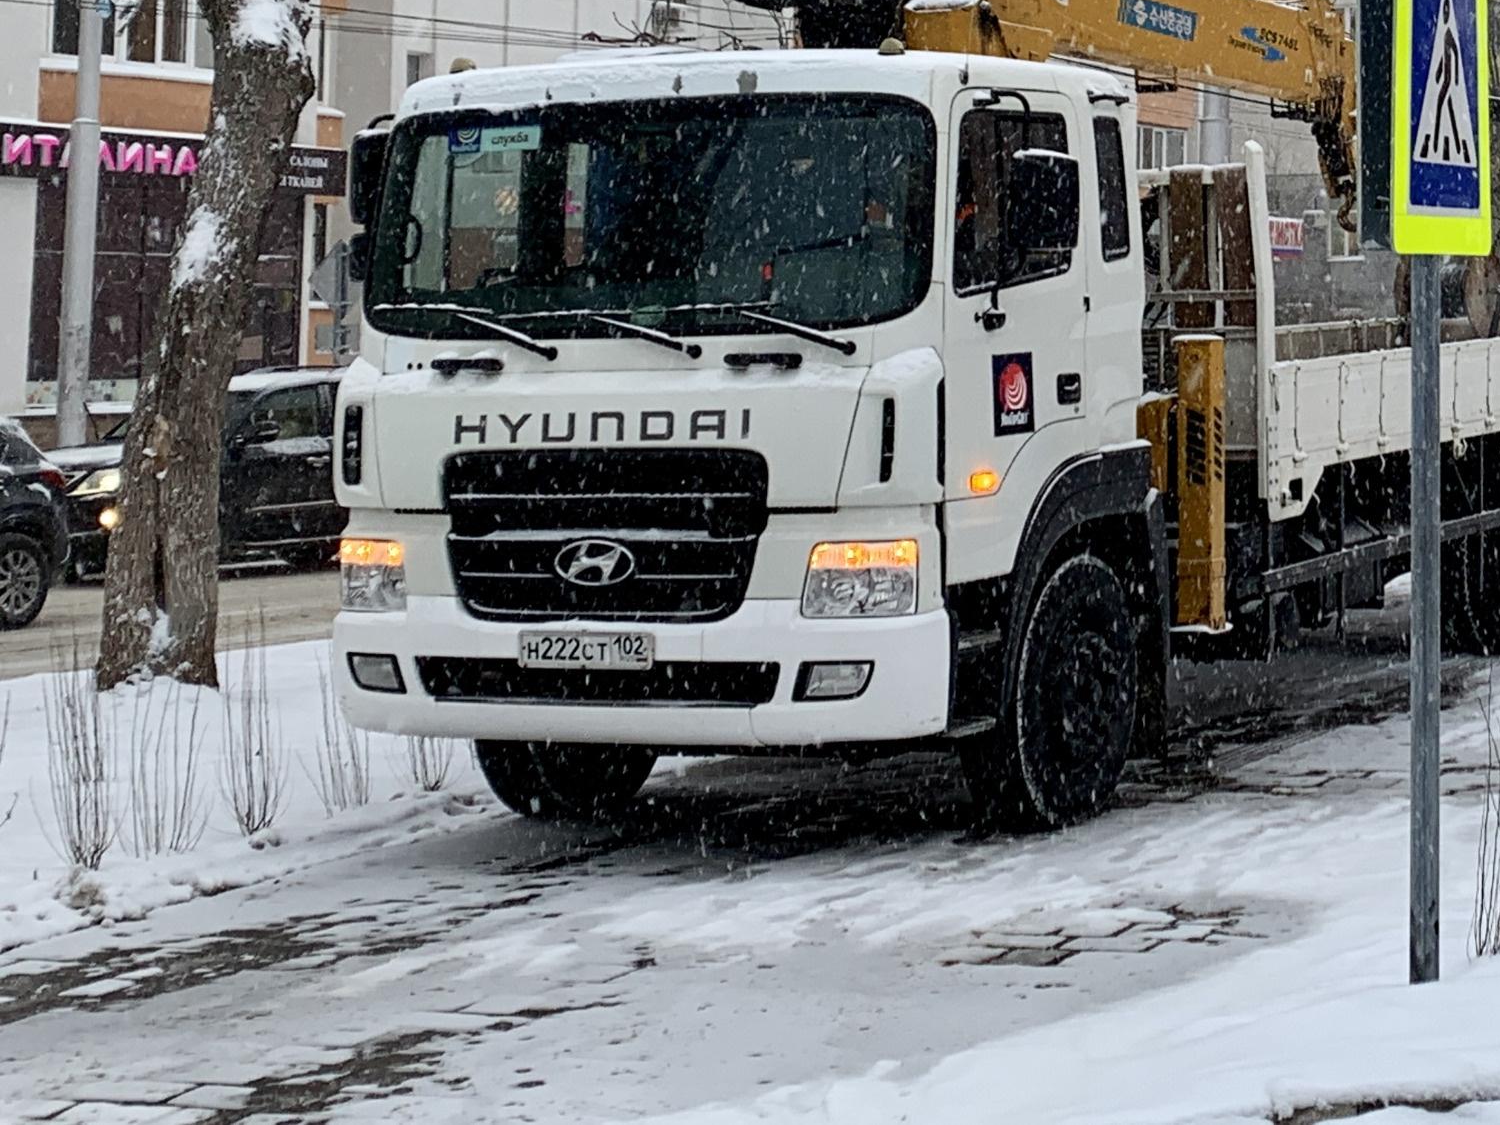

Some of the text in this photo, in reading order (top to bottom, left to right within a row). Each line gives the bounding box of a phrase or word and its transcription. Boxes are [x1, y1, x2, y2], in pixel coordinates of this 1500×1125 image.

[491, 132, 528, 146] служба
[453, 408, 751, 444] HYUNDAI
[527, 635, 644, 661] Н222СТ 102
